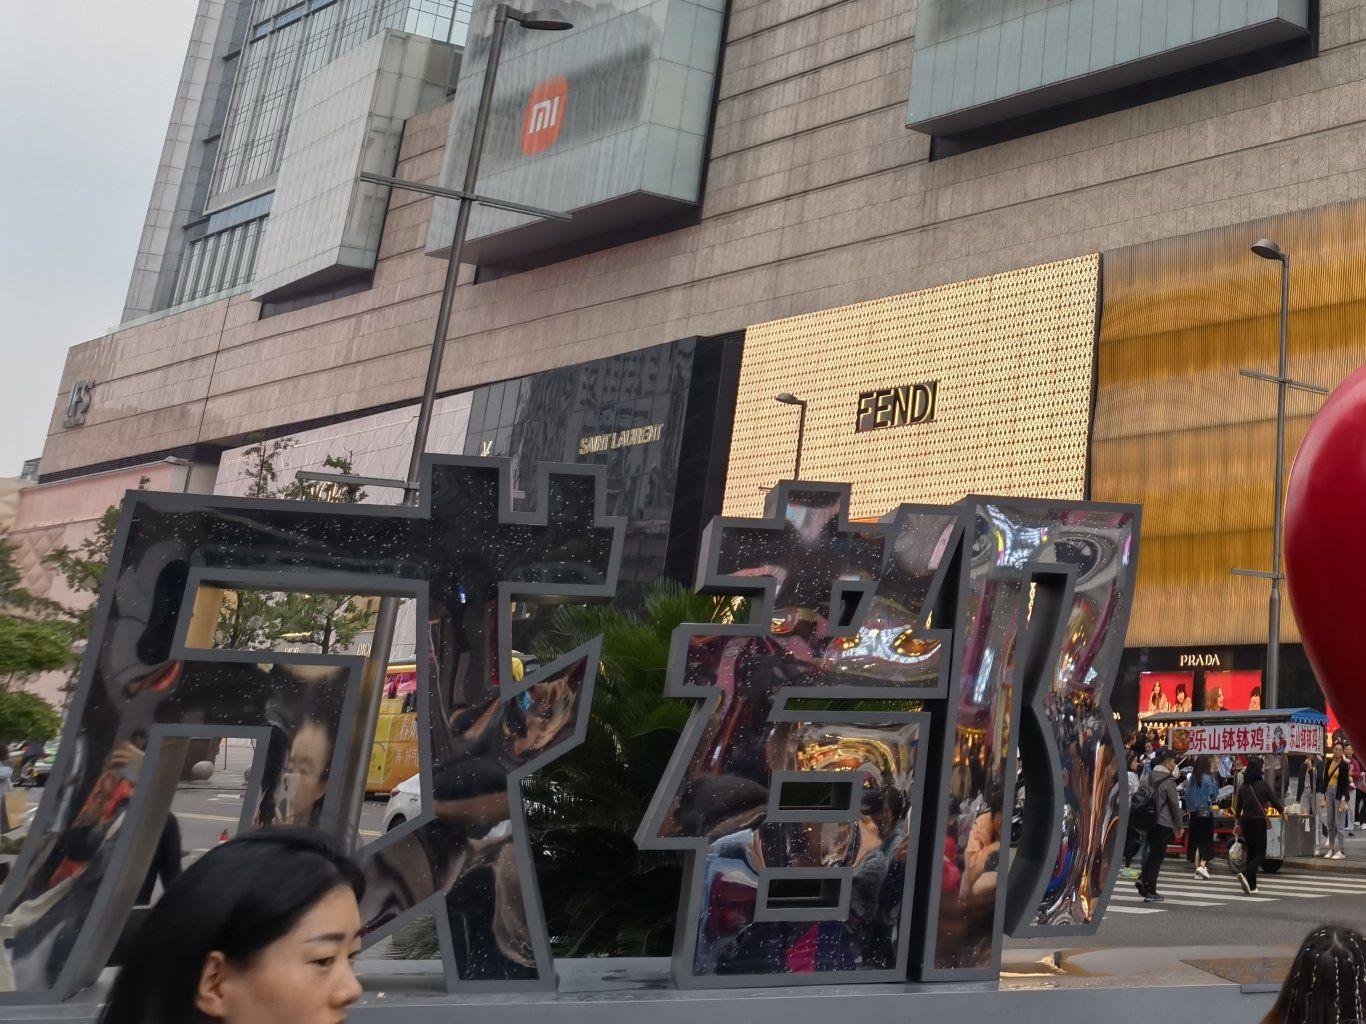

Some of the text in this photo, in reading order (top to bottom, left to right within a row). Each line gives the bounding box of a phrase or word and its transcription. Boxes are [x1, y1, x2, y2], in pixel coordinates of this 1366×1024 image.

[855, 380, 941, 434] FENDI
[578, 423, 665, 455] SAINT LAURENT
[1180, 653, 1221, 667] PRADA
[1195, 726, 1264, 752] 乐山钵钵鸡
